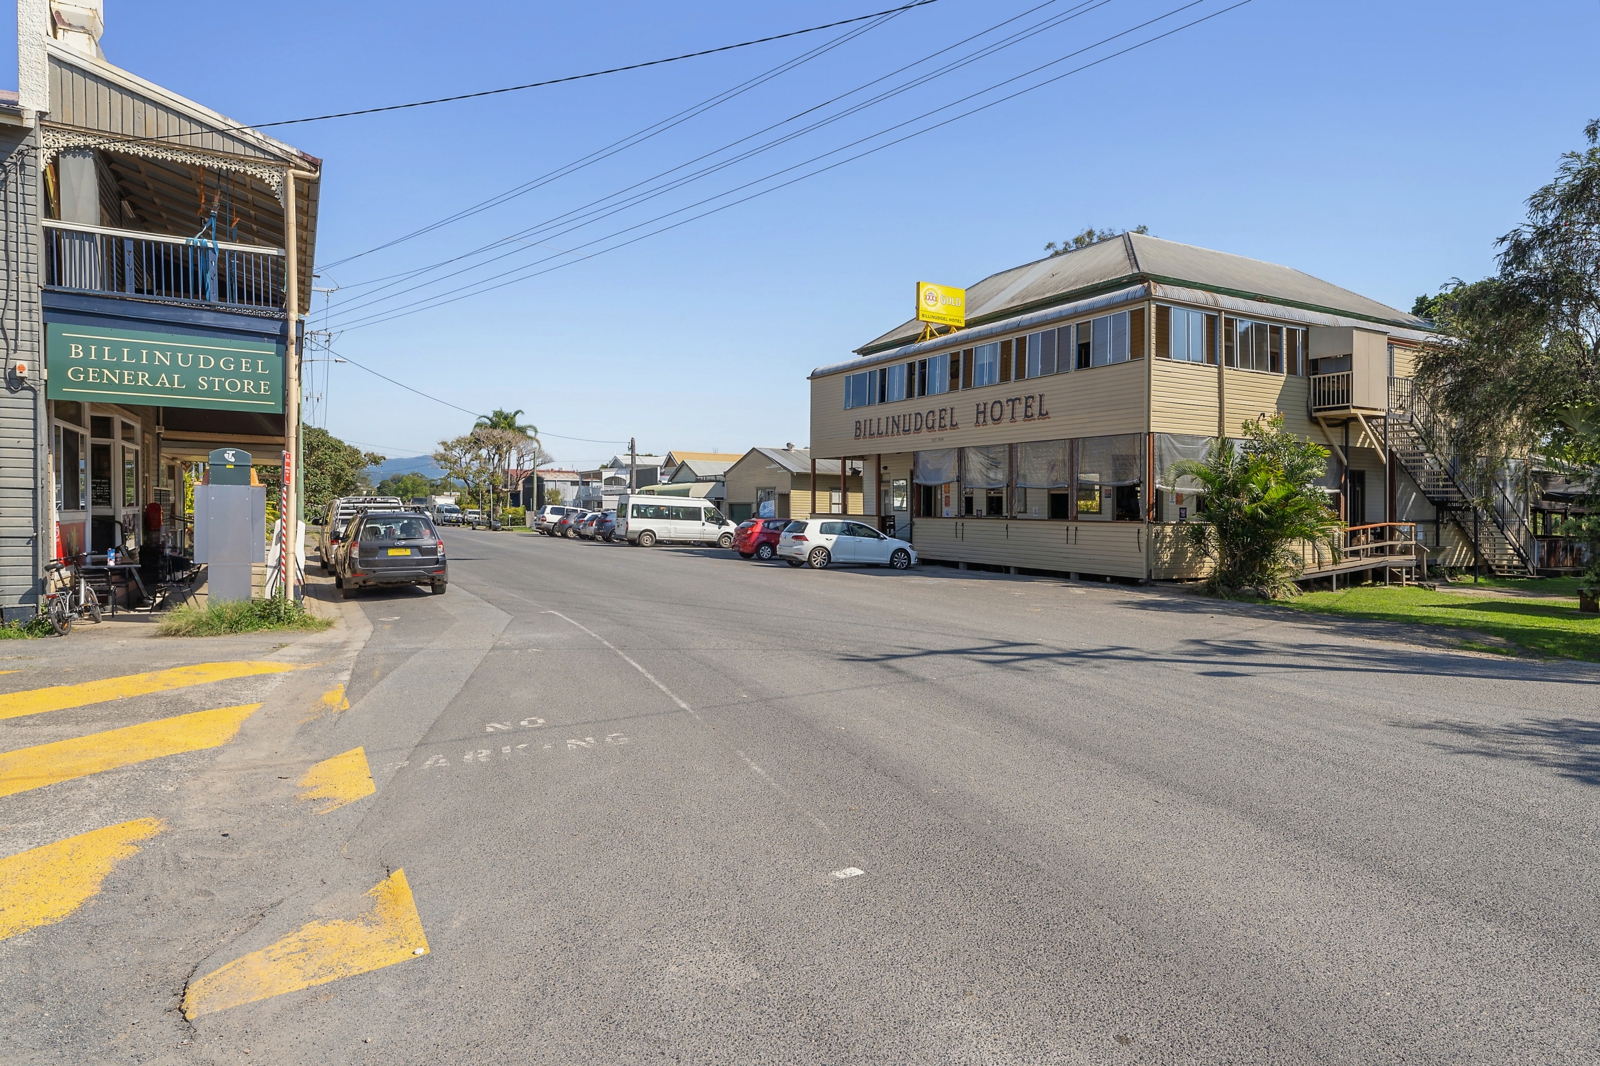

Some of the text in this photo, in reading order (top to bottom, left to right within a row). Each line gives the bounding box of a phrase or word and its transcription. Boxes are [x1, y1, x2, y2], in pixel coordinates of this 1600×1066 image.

[921, 313, 948, 321] BILLINUDGEL
[69, 343, 269, 374] BILLINUDGEL
[67, 366, 271, 395] GENERAL STORE
[853, 393, 1051, 440] BILLINUDGEL HOTEL
[485, 717, 546, 733] NO
